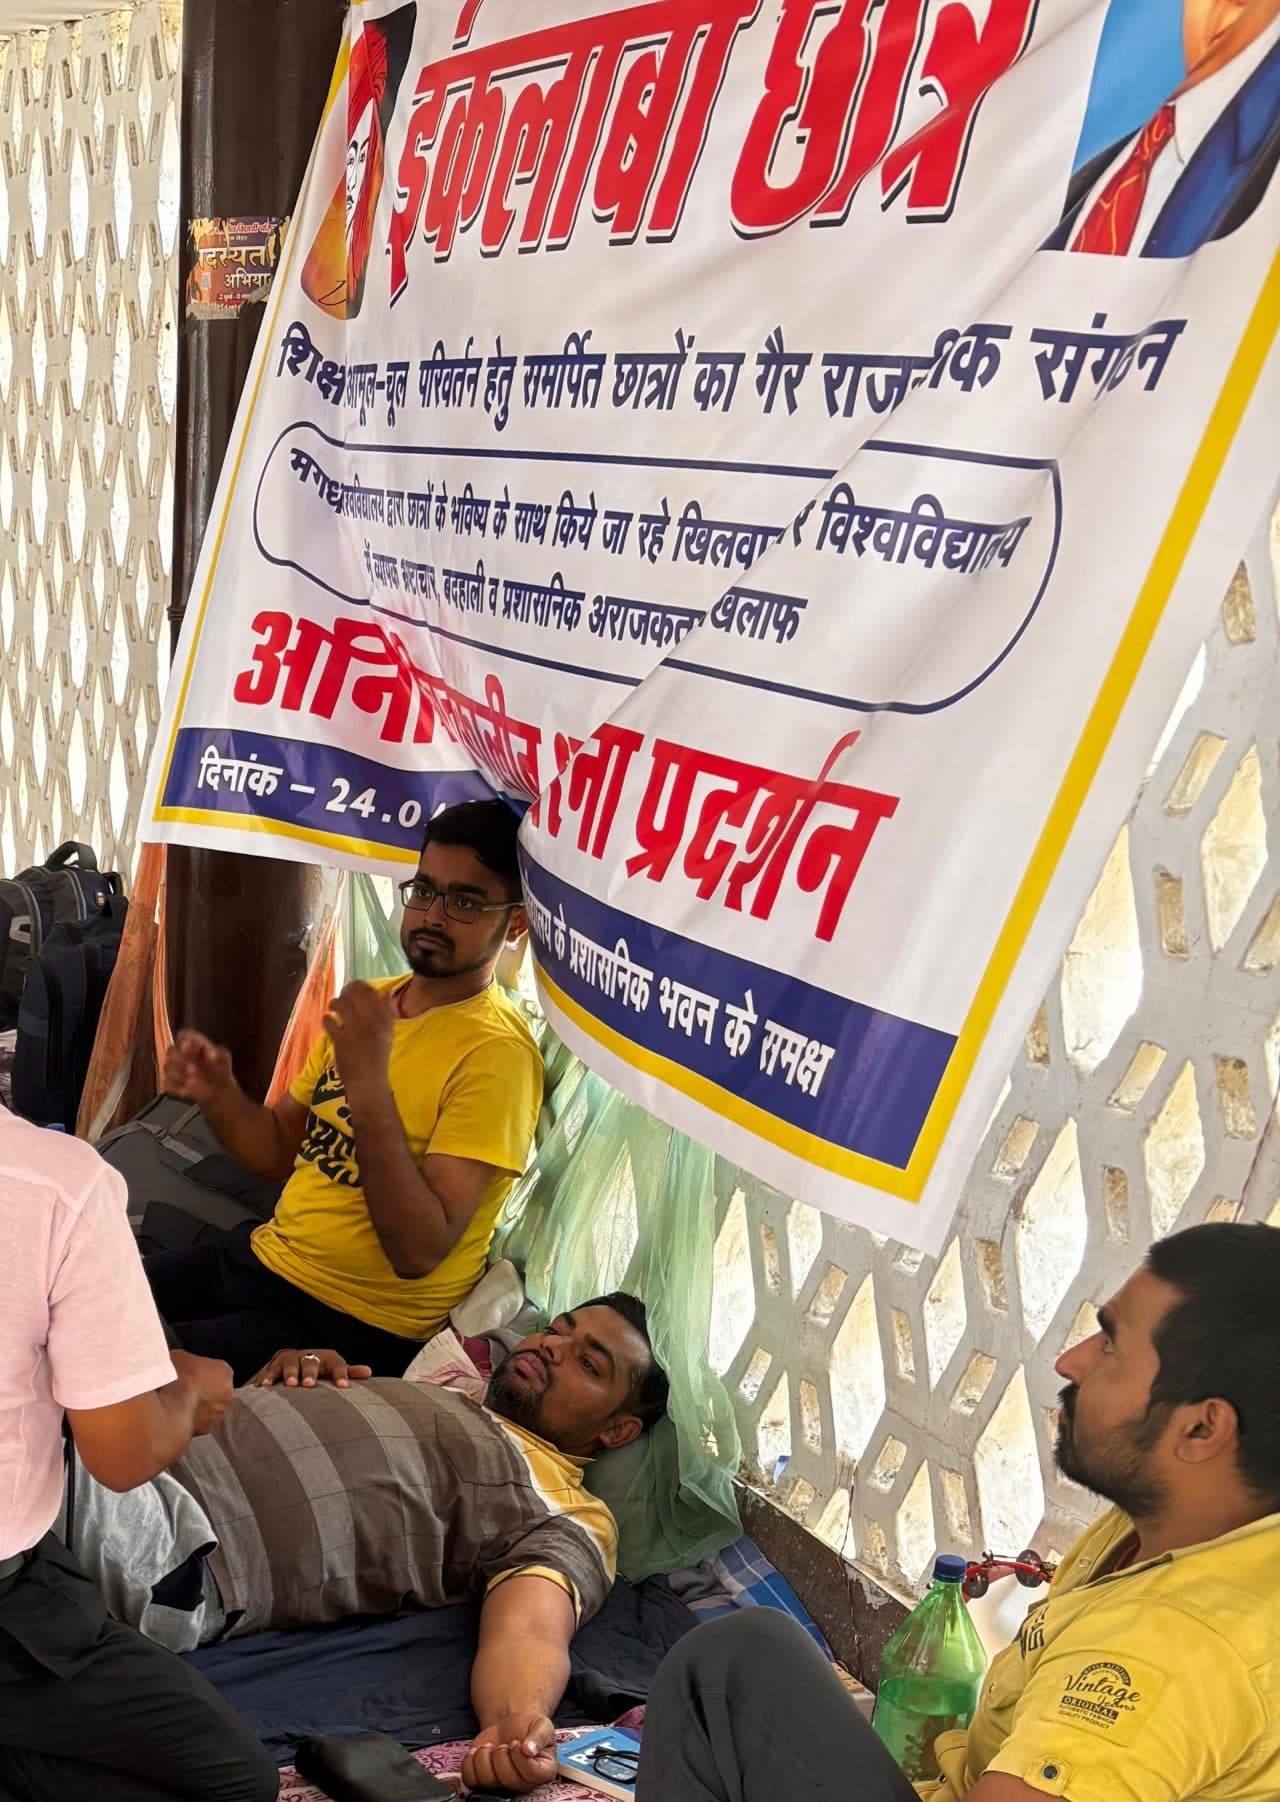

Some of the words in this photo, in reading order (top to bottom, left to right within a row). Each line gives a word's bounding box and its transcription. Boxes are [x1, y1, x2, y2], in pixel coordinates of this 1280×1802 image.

[224, 267, 272, 288] अभिया
[418, 336, 482, 408] परिवर्तन
[484, 335, 517, 432] हेतु
[522, 329, 606, 408] समर्पित
[612, 327, 696, 411] छात्रों
[693, 352, 745, 412] का
[755, 325, 813, 416] गैर
[406, 477, 433, 530] छात्रों
[434, 480, 448, 532] के
[451, 482, 491, 538] भविष्य
[492, 481, 510, 539] के
[514, 502, 552, 545] साथ
[552, 490, 597, 550] किये
[603, 510, 634, 555] जा
[638, 496, 671, 564] रहे
[441, 558, 485, 613] बदहाली
[488, 577, 500, 618] व
[501, 571, 586, 632] प्रशासनिक
[197, 744, 283, 797] दिनांक
[324, 776, 447, 829] 24.0
[625, 729, 901, 943] प्रदर्शन
[553, 903, 567, 961] के
[569, 938, 654, 1013] प्रशासनिक
[657, 975, 719, 1046] भवन
[723, 989, 759, 1058] के
[759, 1018, 836, 1098] समक्ष
[1064, 1675, 1141, 1704] Vintage
